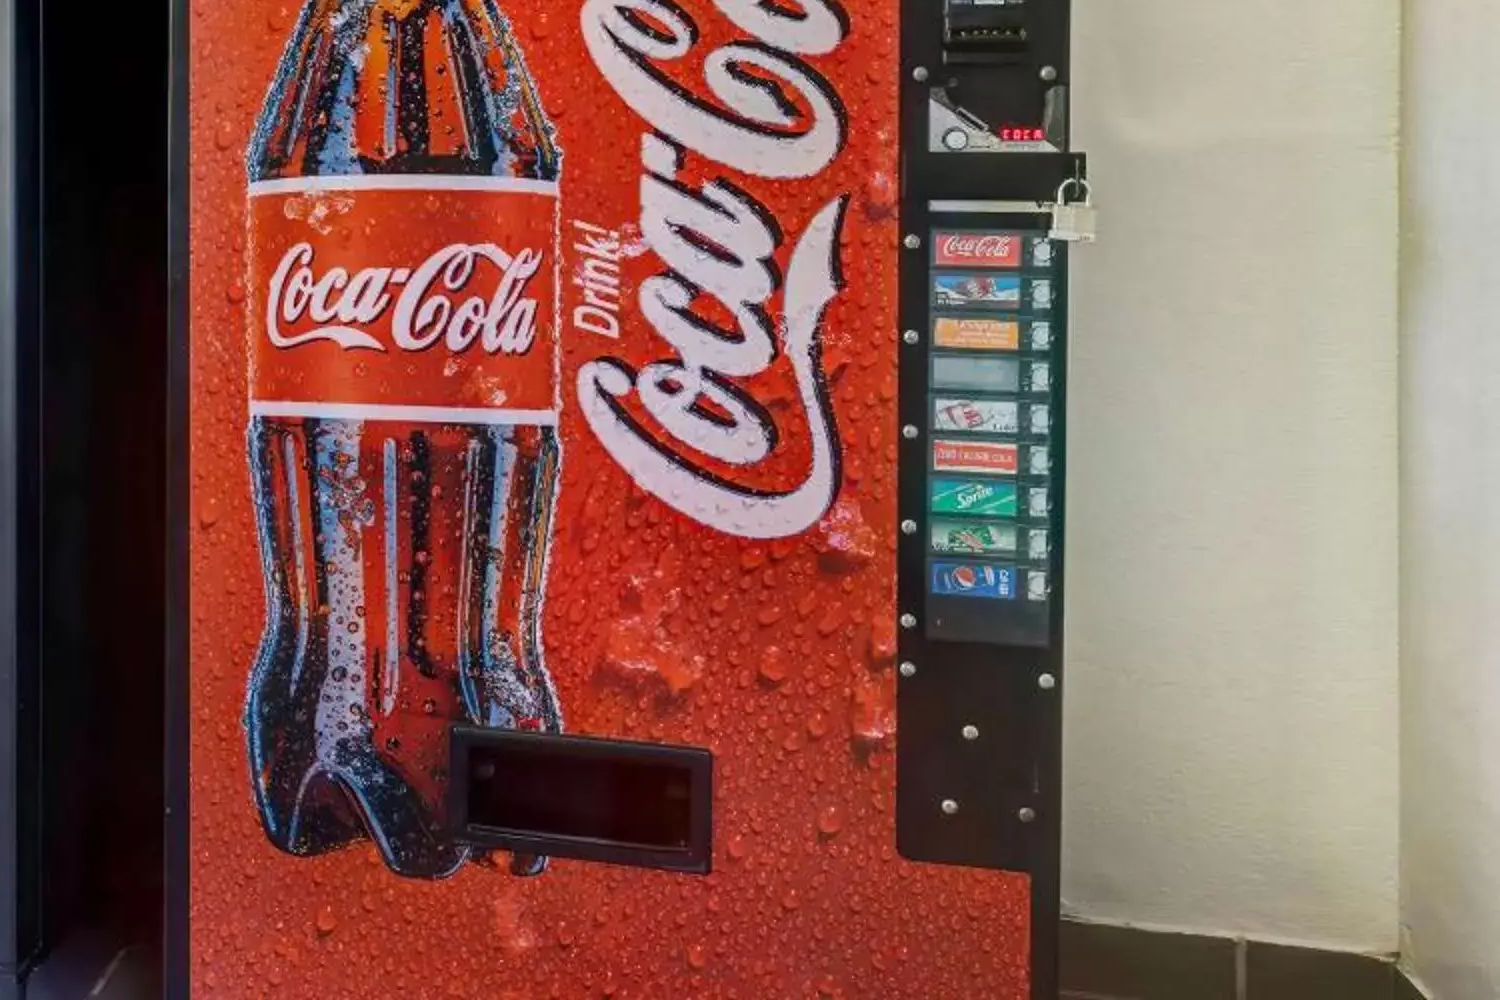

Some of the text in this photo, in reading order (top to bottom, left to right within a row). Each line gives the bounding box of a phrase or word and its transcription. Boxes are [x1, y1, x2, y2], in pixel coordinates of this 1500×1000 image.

[266, 242, 543, 356] Coca-Cola
[572, 219, 620, 339] Drink!
[956, 484, 995, 509] Sprite
